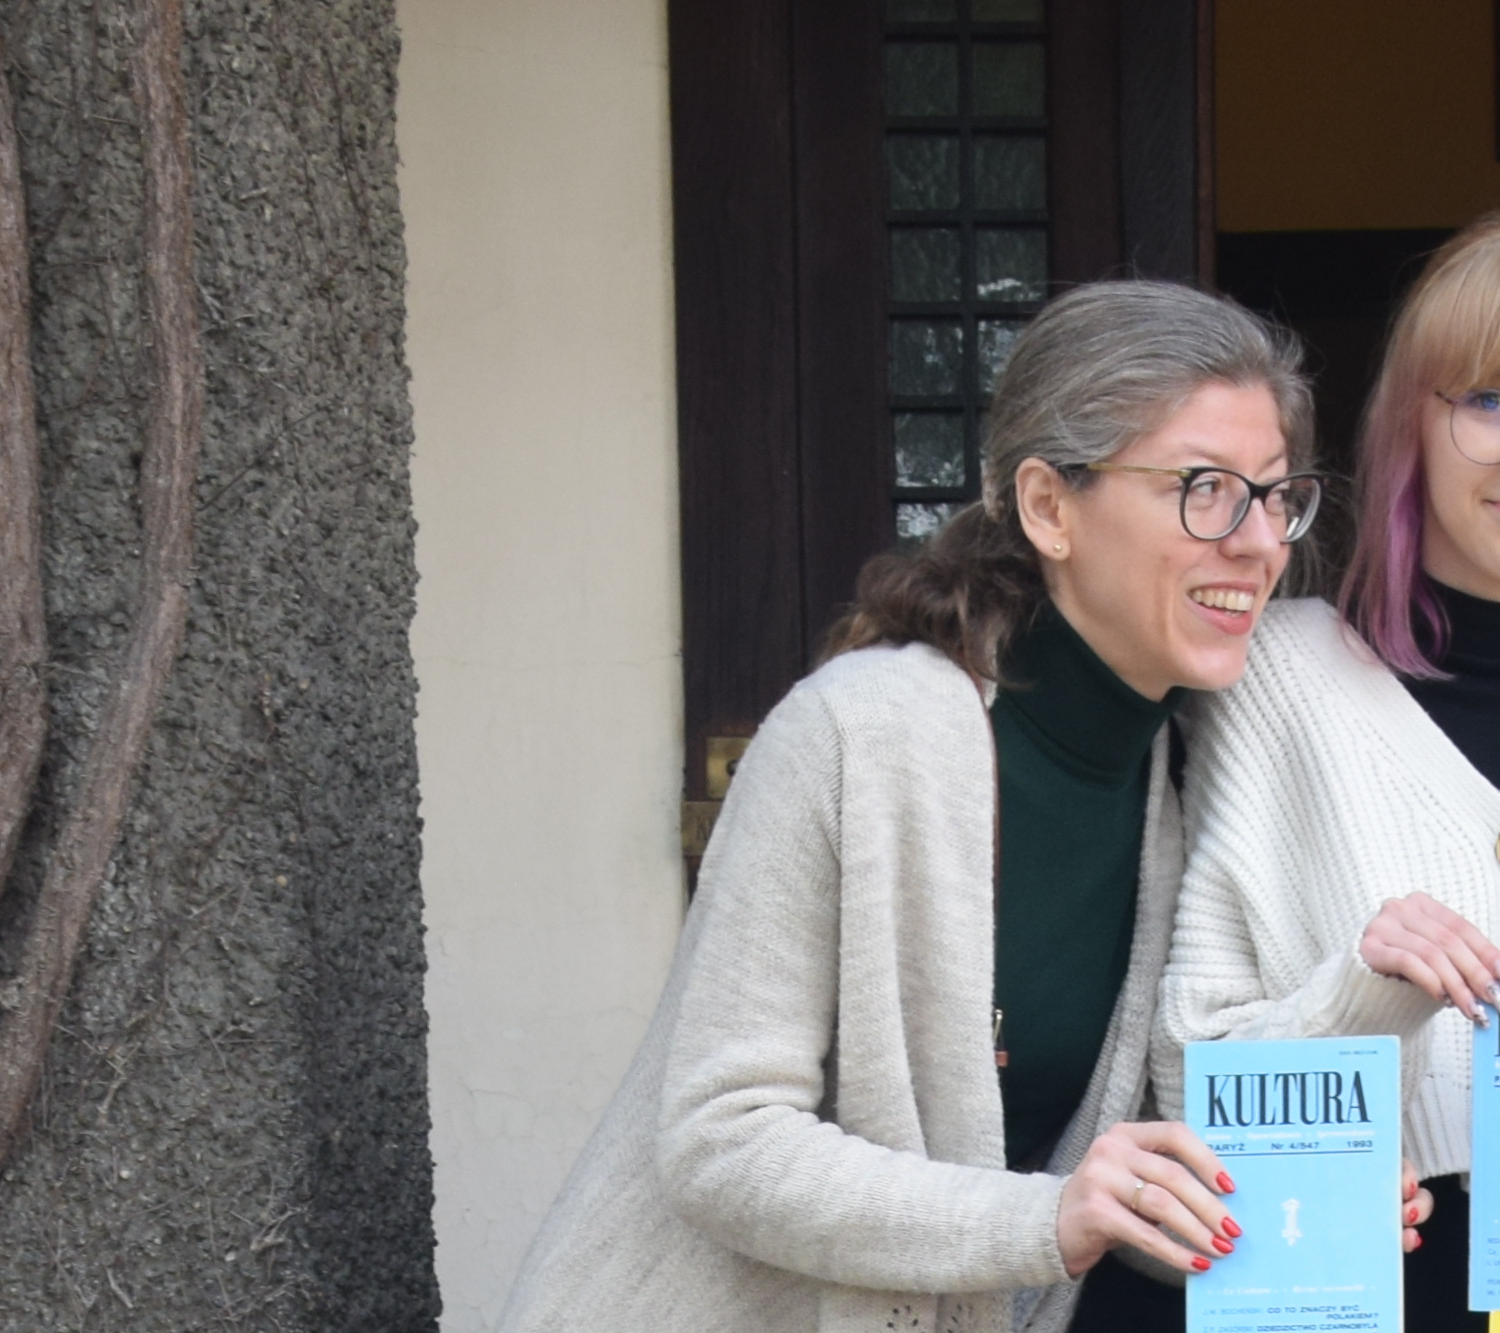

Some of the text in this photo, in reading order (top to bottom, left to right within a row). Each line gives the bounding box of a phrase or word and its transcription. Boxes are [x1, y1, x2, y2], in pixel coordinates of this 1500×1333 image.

[1205, 1071, 1373, 1128] KULTURA
[1271, 1143, 1285, 1151] Nr
[1289, 1141, 1320, 1150] 4/547
[1347, 1140, 1373, 1148] 1993
